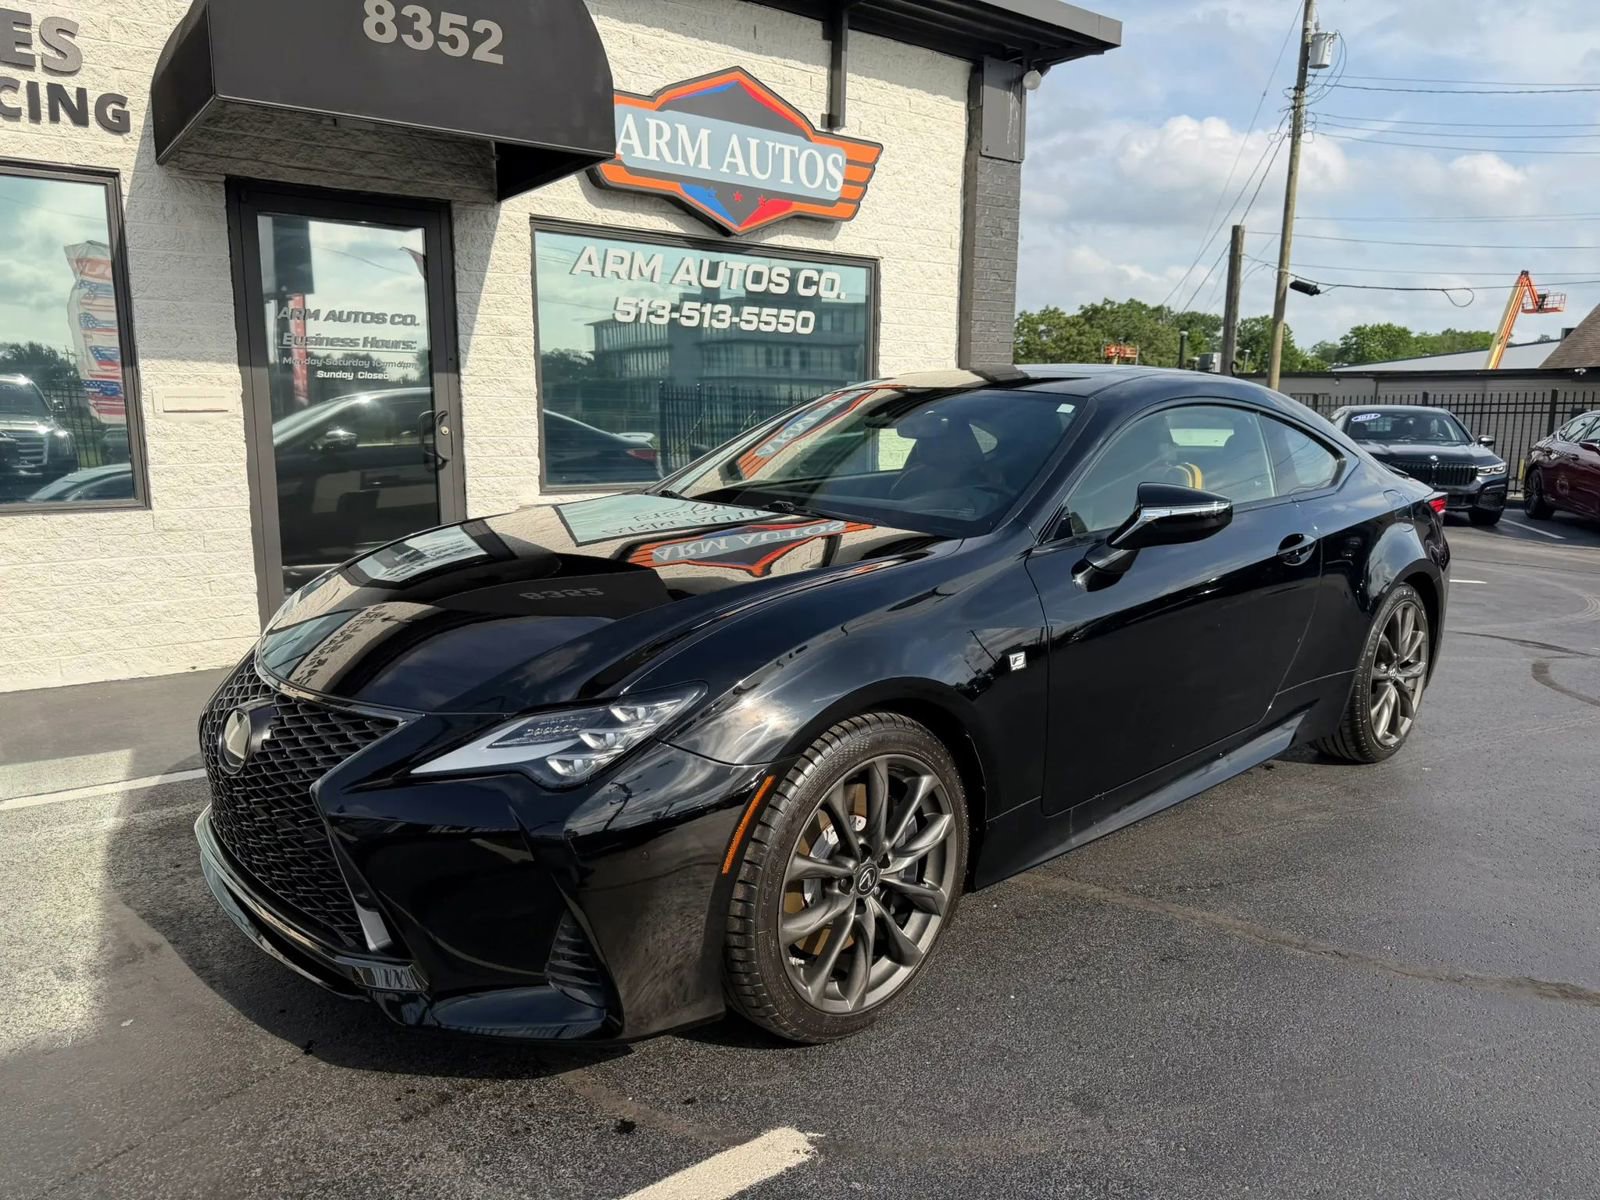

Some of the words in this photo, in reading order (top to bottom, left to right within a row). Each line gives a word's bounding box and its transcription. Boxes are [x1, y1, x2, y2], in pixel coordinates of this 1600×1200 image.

[0, 8, 83, 77] ES
[363, 0, 504, 65] 8352
[616, 113, 712, 170] ARM
[720, 134, 844, 193] AUTOS
[570, 245, 664, 283] ARM
[672, 256, 790, 294] AUTOS
[796, 268, 846, 300] CO.
[277, 306, 321, 322] ARM
[323, 309, 388, 325] AUTOS
[389, 313, 420, 327] CO.
[614, 297, 816, 335] 513-513-5550
[282, 332, 360, 348] Business
[362, 336, 417, 351] Hours:
[316, 370, 354, 380] Sunday
